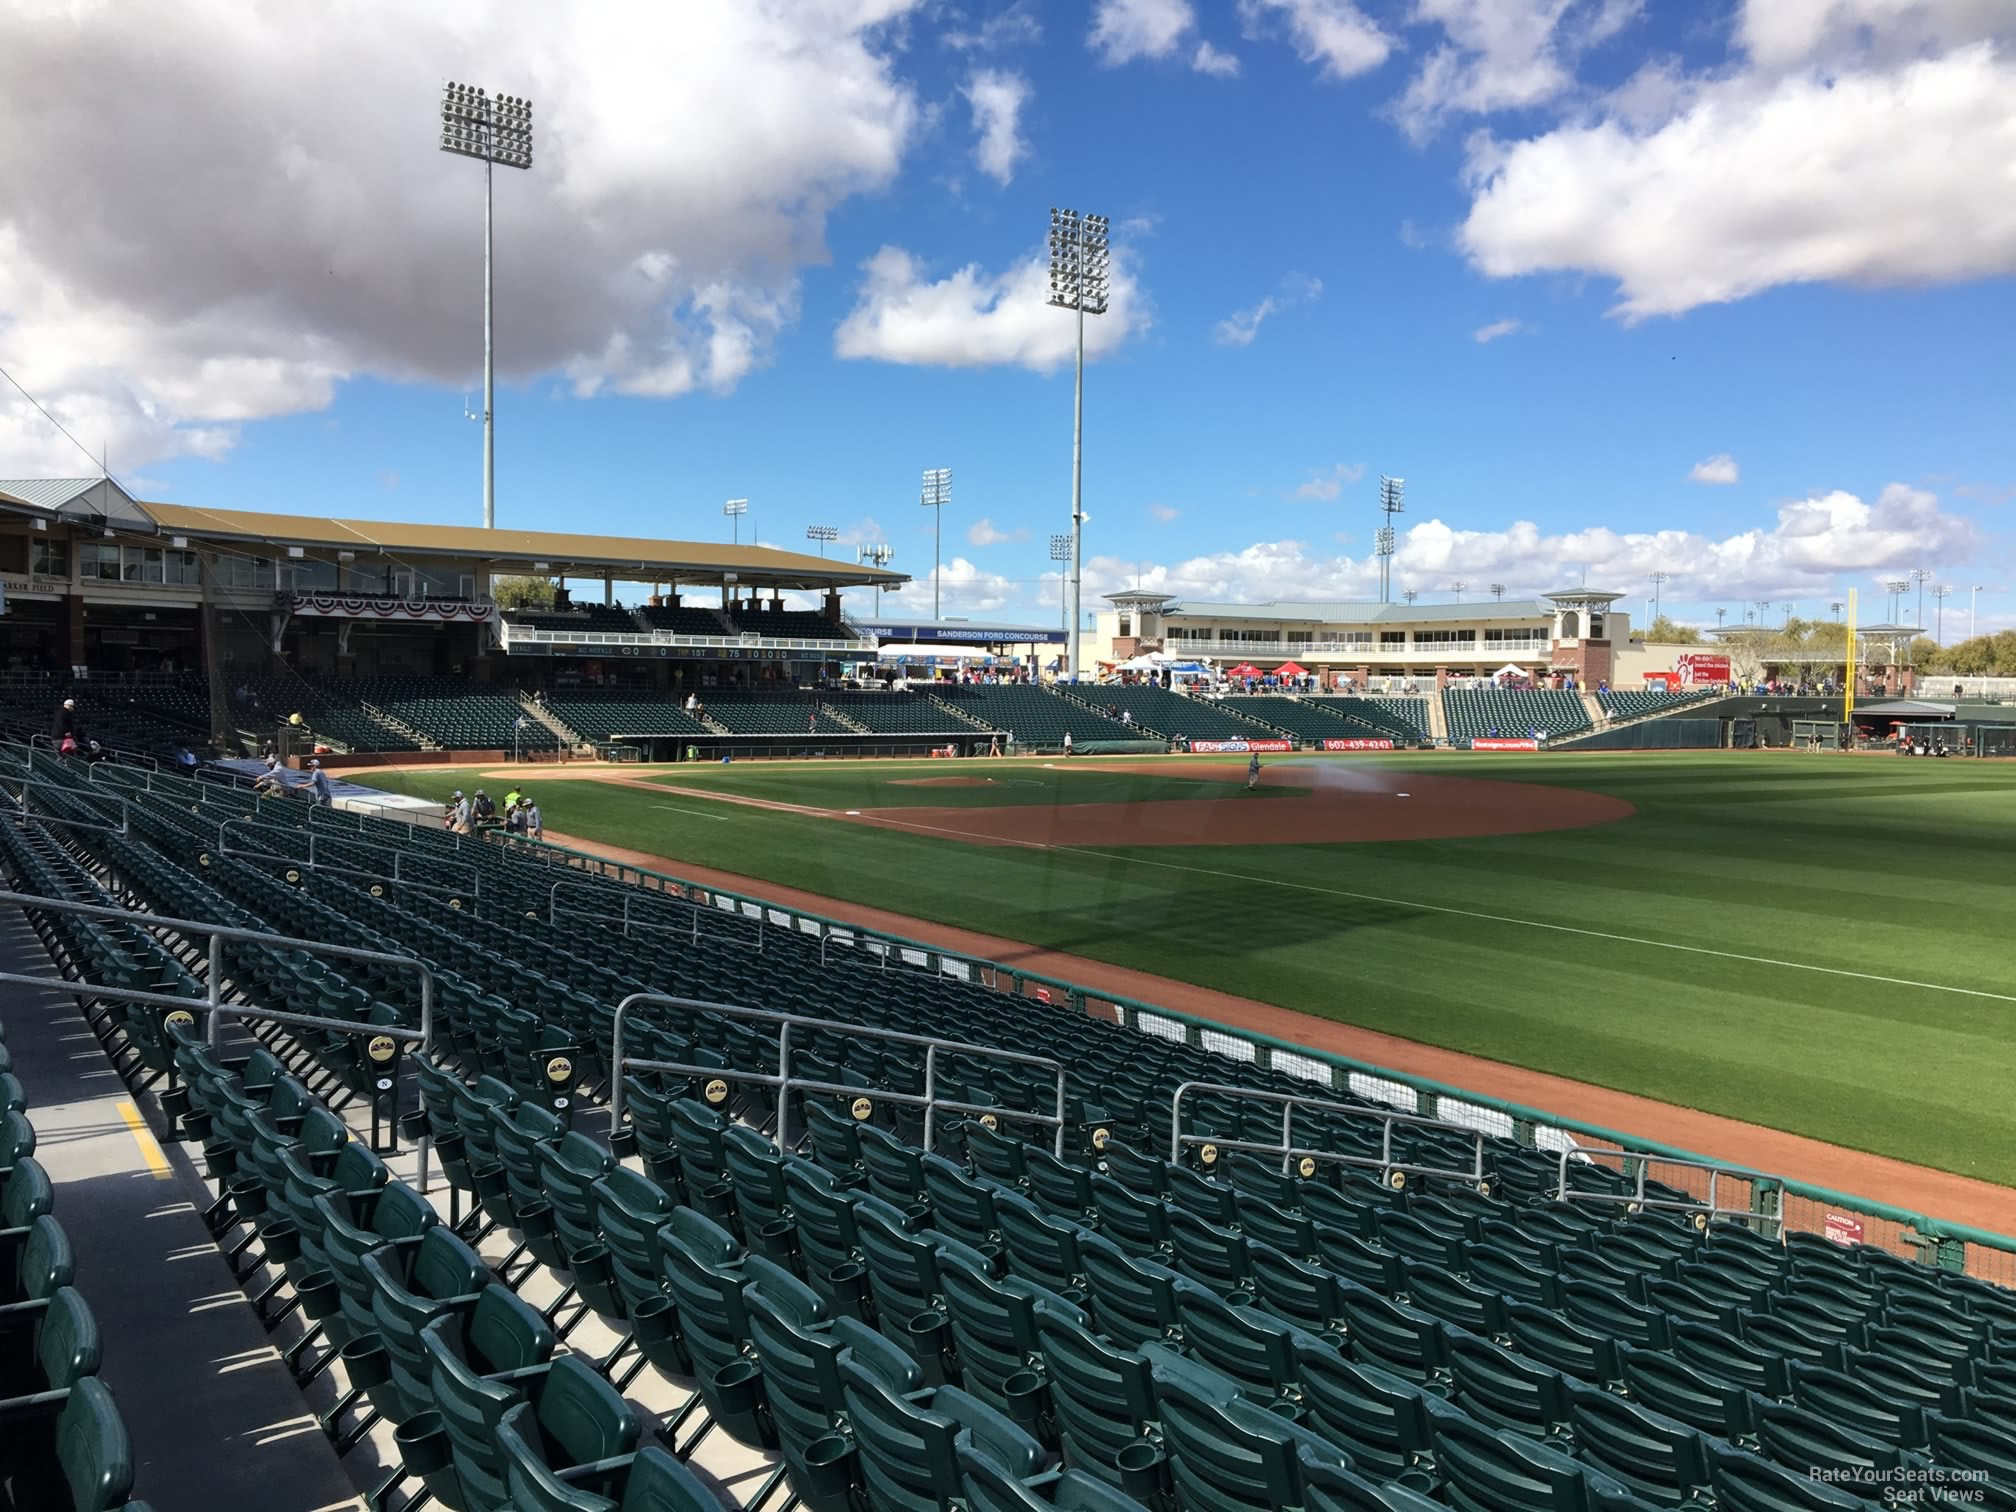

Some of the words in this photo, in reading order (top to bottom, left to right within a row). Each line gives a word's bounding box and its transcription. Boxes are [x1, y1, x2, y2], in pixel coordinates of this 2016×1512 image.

[936, 630, 983, 639] SANDERSON
[984, 631, 1003, 639] FORD
[1004, 632, 1049, 641] CONCOURSE
[691, 649, 706, 657] 1ST
[729, 649, 740, 658] 75
[1250, 742, 1287, 751] Glendale
[1328, 740, 1390, 750] 602-439-4242
[1826, 1213, 1854, 1227] CAUTION
